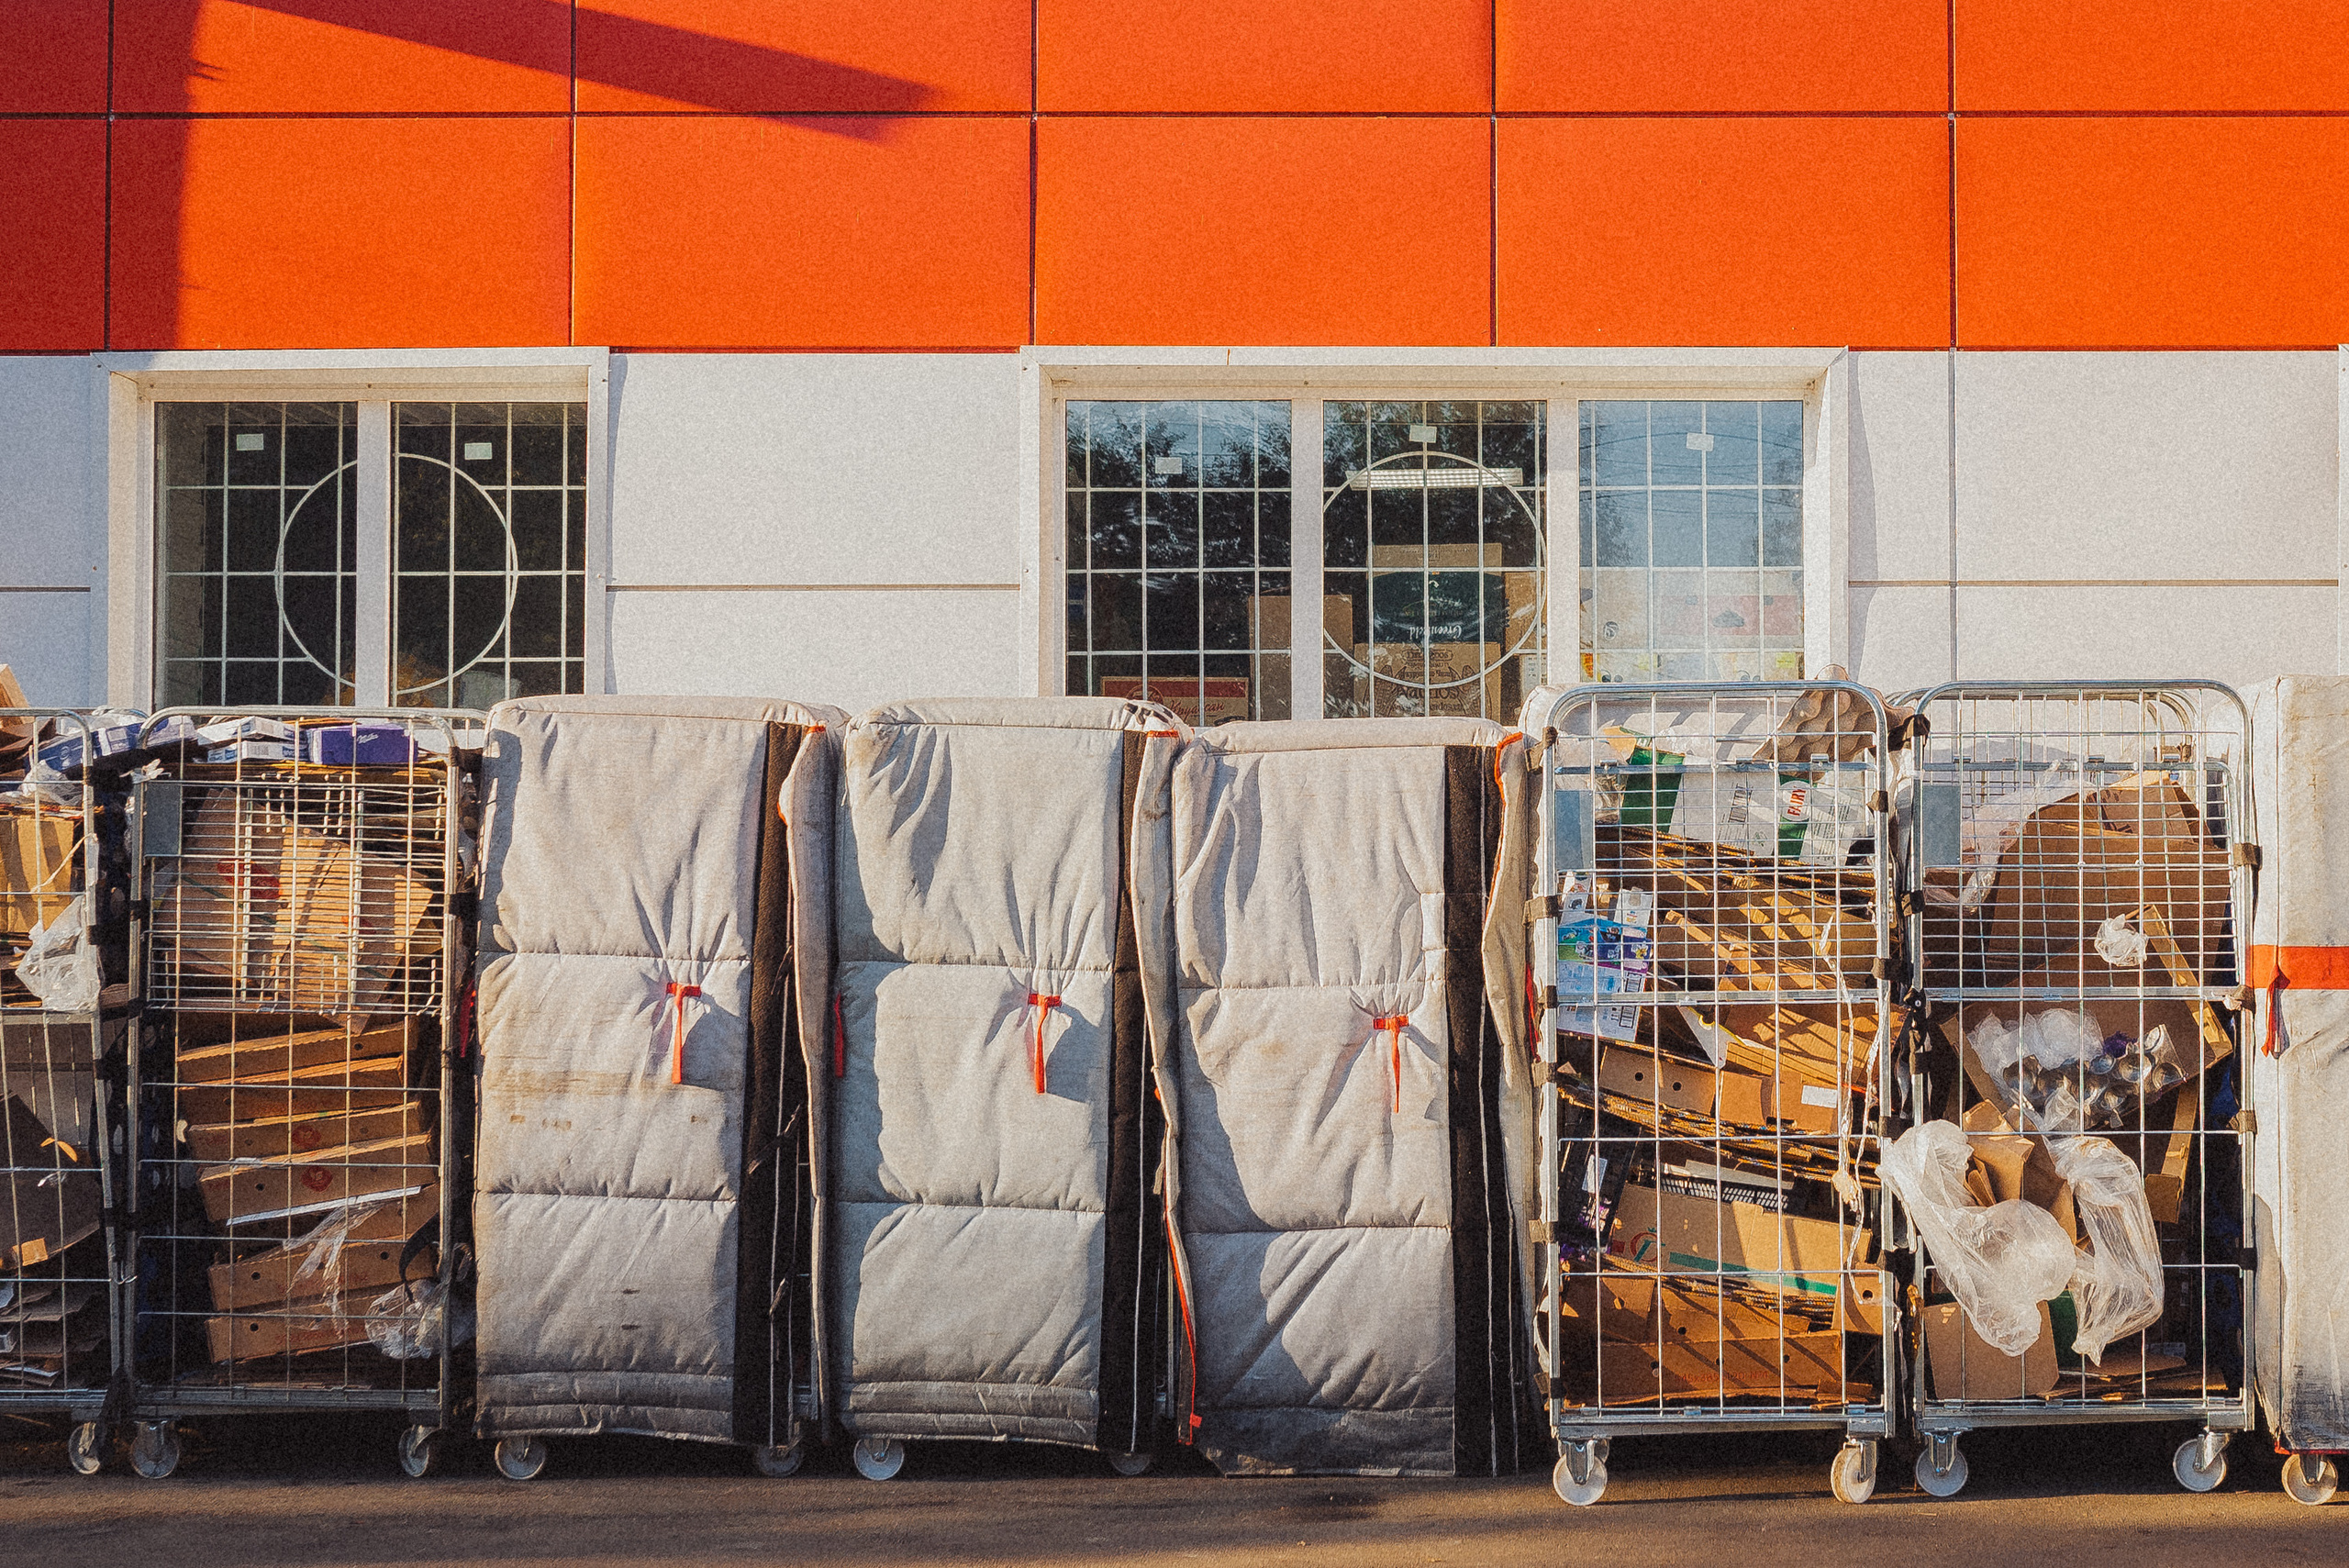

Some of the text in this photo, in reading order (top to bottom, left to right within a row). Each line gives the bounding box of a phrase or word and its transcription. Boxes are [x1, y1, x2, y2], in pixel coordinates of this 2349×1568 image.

[1409, 626, 1462, 639] Greeneld
[1170, 700, 1225, 723] Круасан
[1787, 785, 1806, 816] FAIRY
